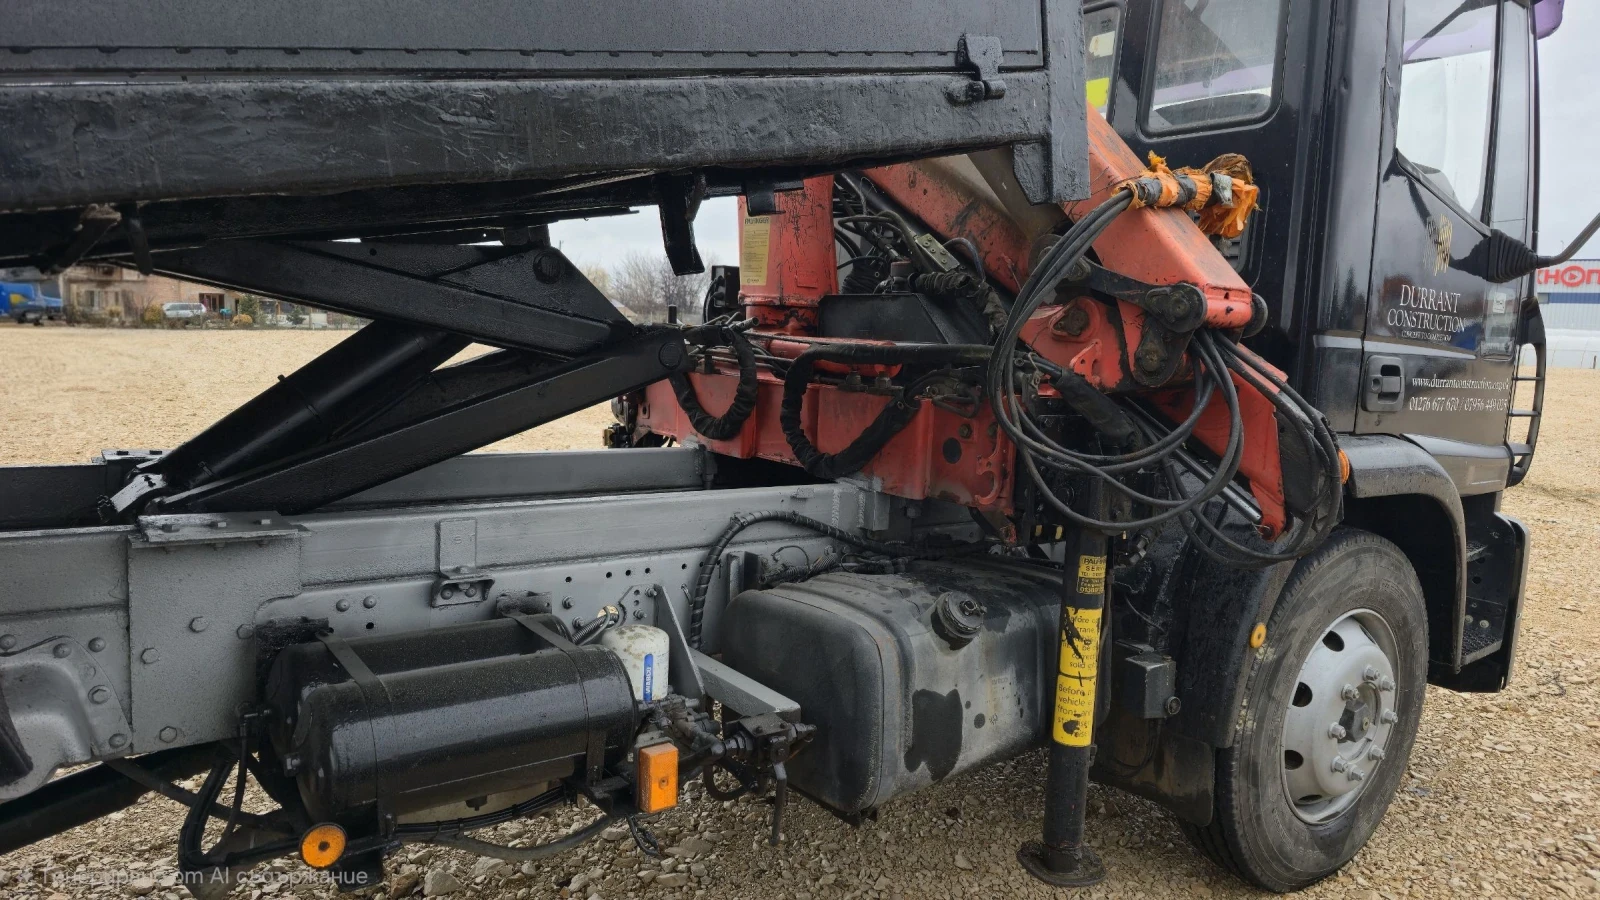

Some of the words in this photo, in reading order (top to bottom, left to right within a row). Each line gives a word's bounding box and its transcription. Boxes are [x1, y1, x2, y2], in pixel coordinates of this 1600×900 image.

[1399, 284, 1461, 314] DURRANT
[1387, 308, 1466, 333] CONSTRUCTION
[1409, 396, 1431, 412] 01276
[1432, 396, 1446, 412] 677
[1058, 683, 1086, 696] Before
[1058, 695, 1086, 707] vehicle
[1057, 704, 1078, 716] front
